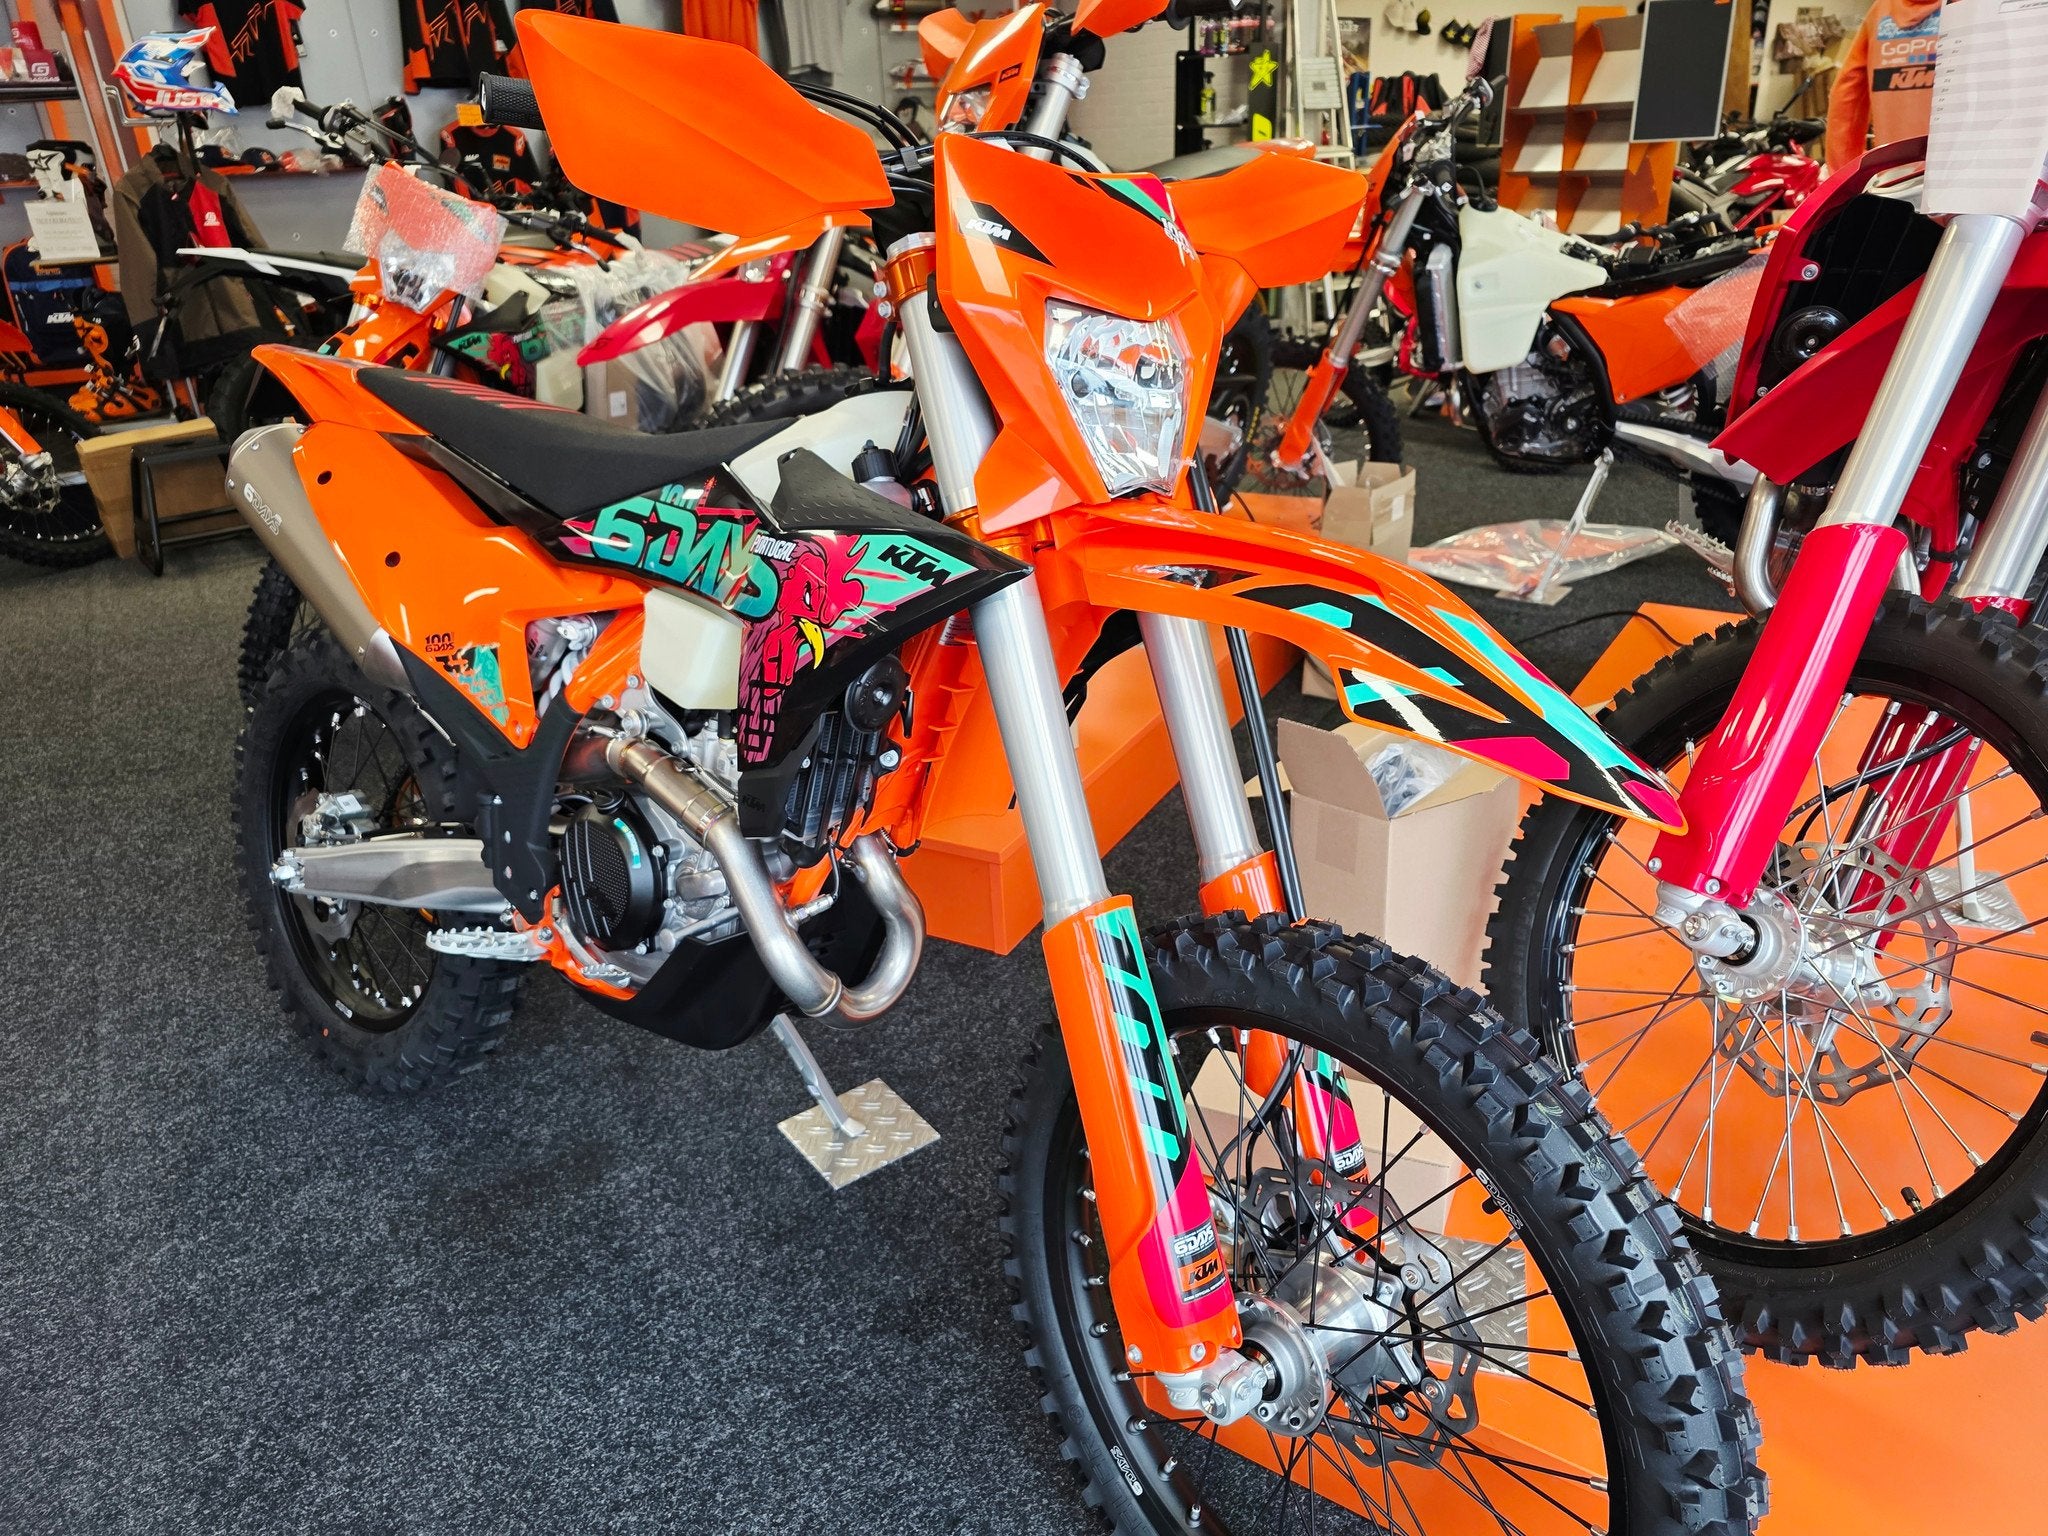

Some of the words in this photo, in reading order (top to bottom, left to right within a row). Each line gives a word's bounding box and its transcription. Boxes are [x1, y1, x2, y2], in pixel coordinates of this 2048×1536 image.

[1889, 66, 1936, 89] KTM
[965, 218, 1012, 241] KTM
[593, 496, 779, 618] 6DAYS
[750, 534, 797, 562] PORTUGAL
[877, 543, 952, 588] KTM
[425, 632, 451, 644] 100
[425, 642, 455, 652] 6DAYS
[1475, 1168, 1523, 1230] 6DAYS
[1174, 1225, 1215, 1256] 6DAYS
[1188, 1258, 1218, 1286] KTM
[1110, 1445, 1144, 1497] 6DAYS
